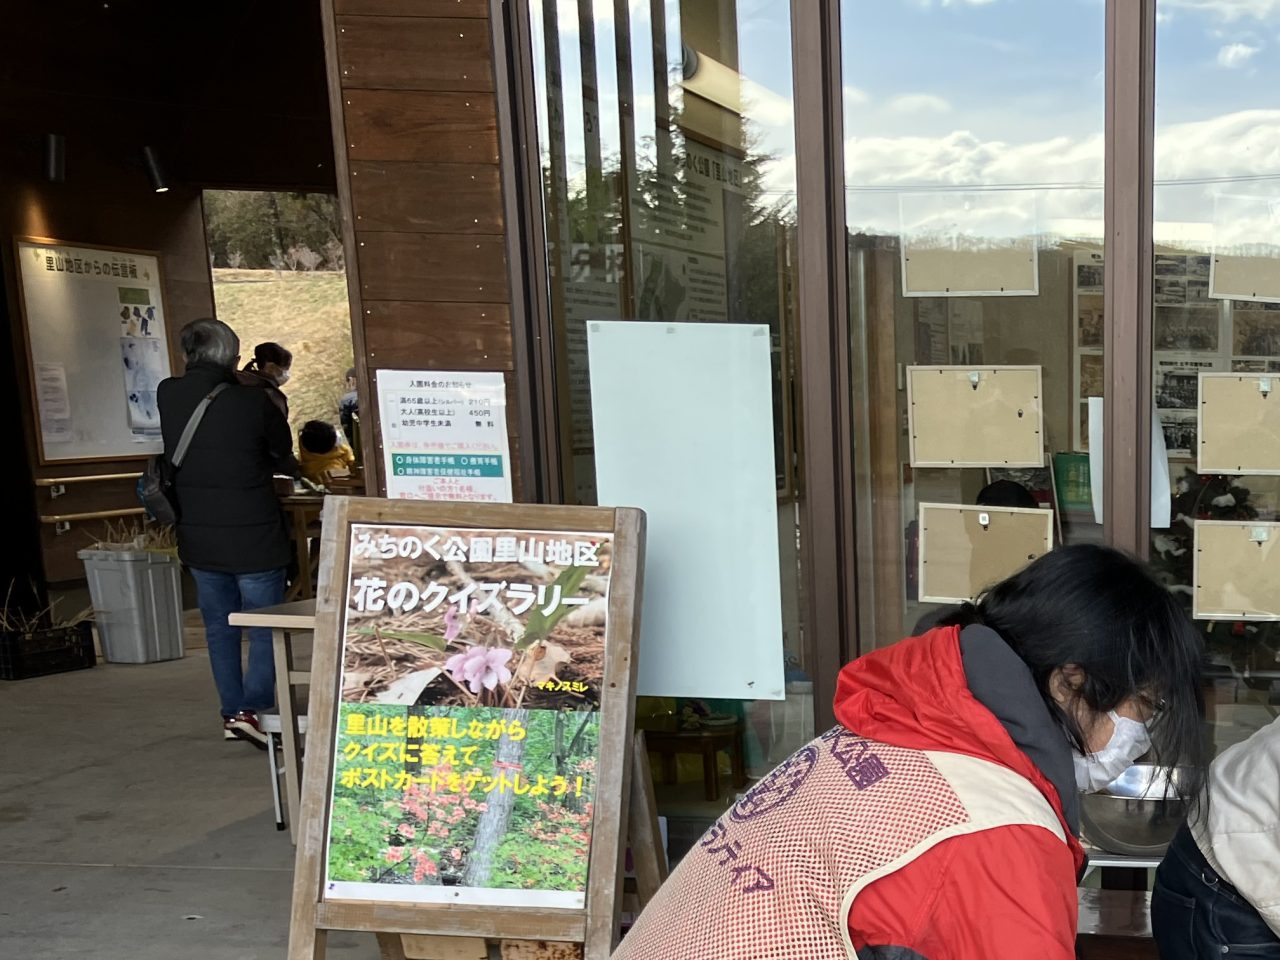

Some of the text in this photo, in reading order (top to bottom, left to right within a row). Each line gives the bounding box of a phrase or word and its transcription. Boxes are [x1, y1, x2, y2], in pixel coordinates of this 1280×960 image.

[46, 256, 138, 279] 里山地区からの伝言板
[409, 379, 472, 389] 入園料金のお知らせ
[468, 409, 491, 417] 450円
[353, 534, 600, 567] みちのく公園里山地区
[353, 577, 591, 617] 花のクイズラリー
[535, 680, 589, 693] マキノスミレ
[345, 713, 526, 741] 里山を散策しながら
[341, 741, 479, 765] クイズに答えて
